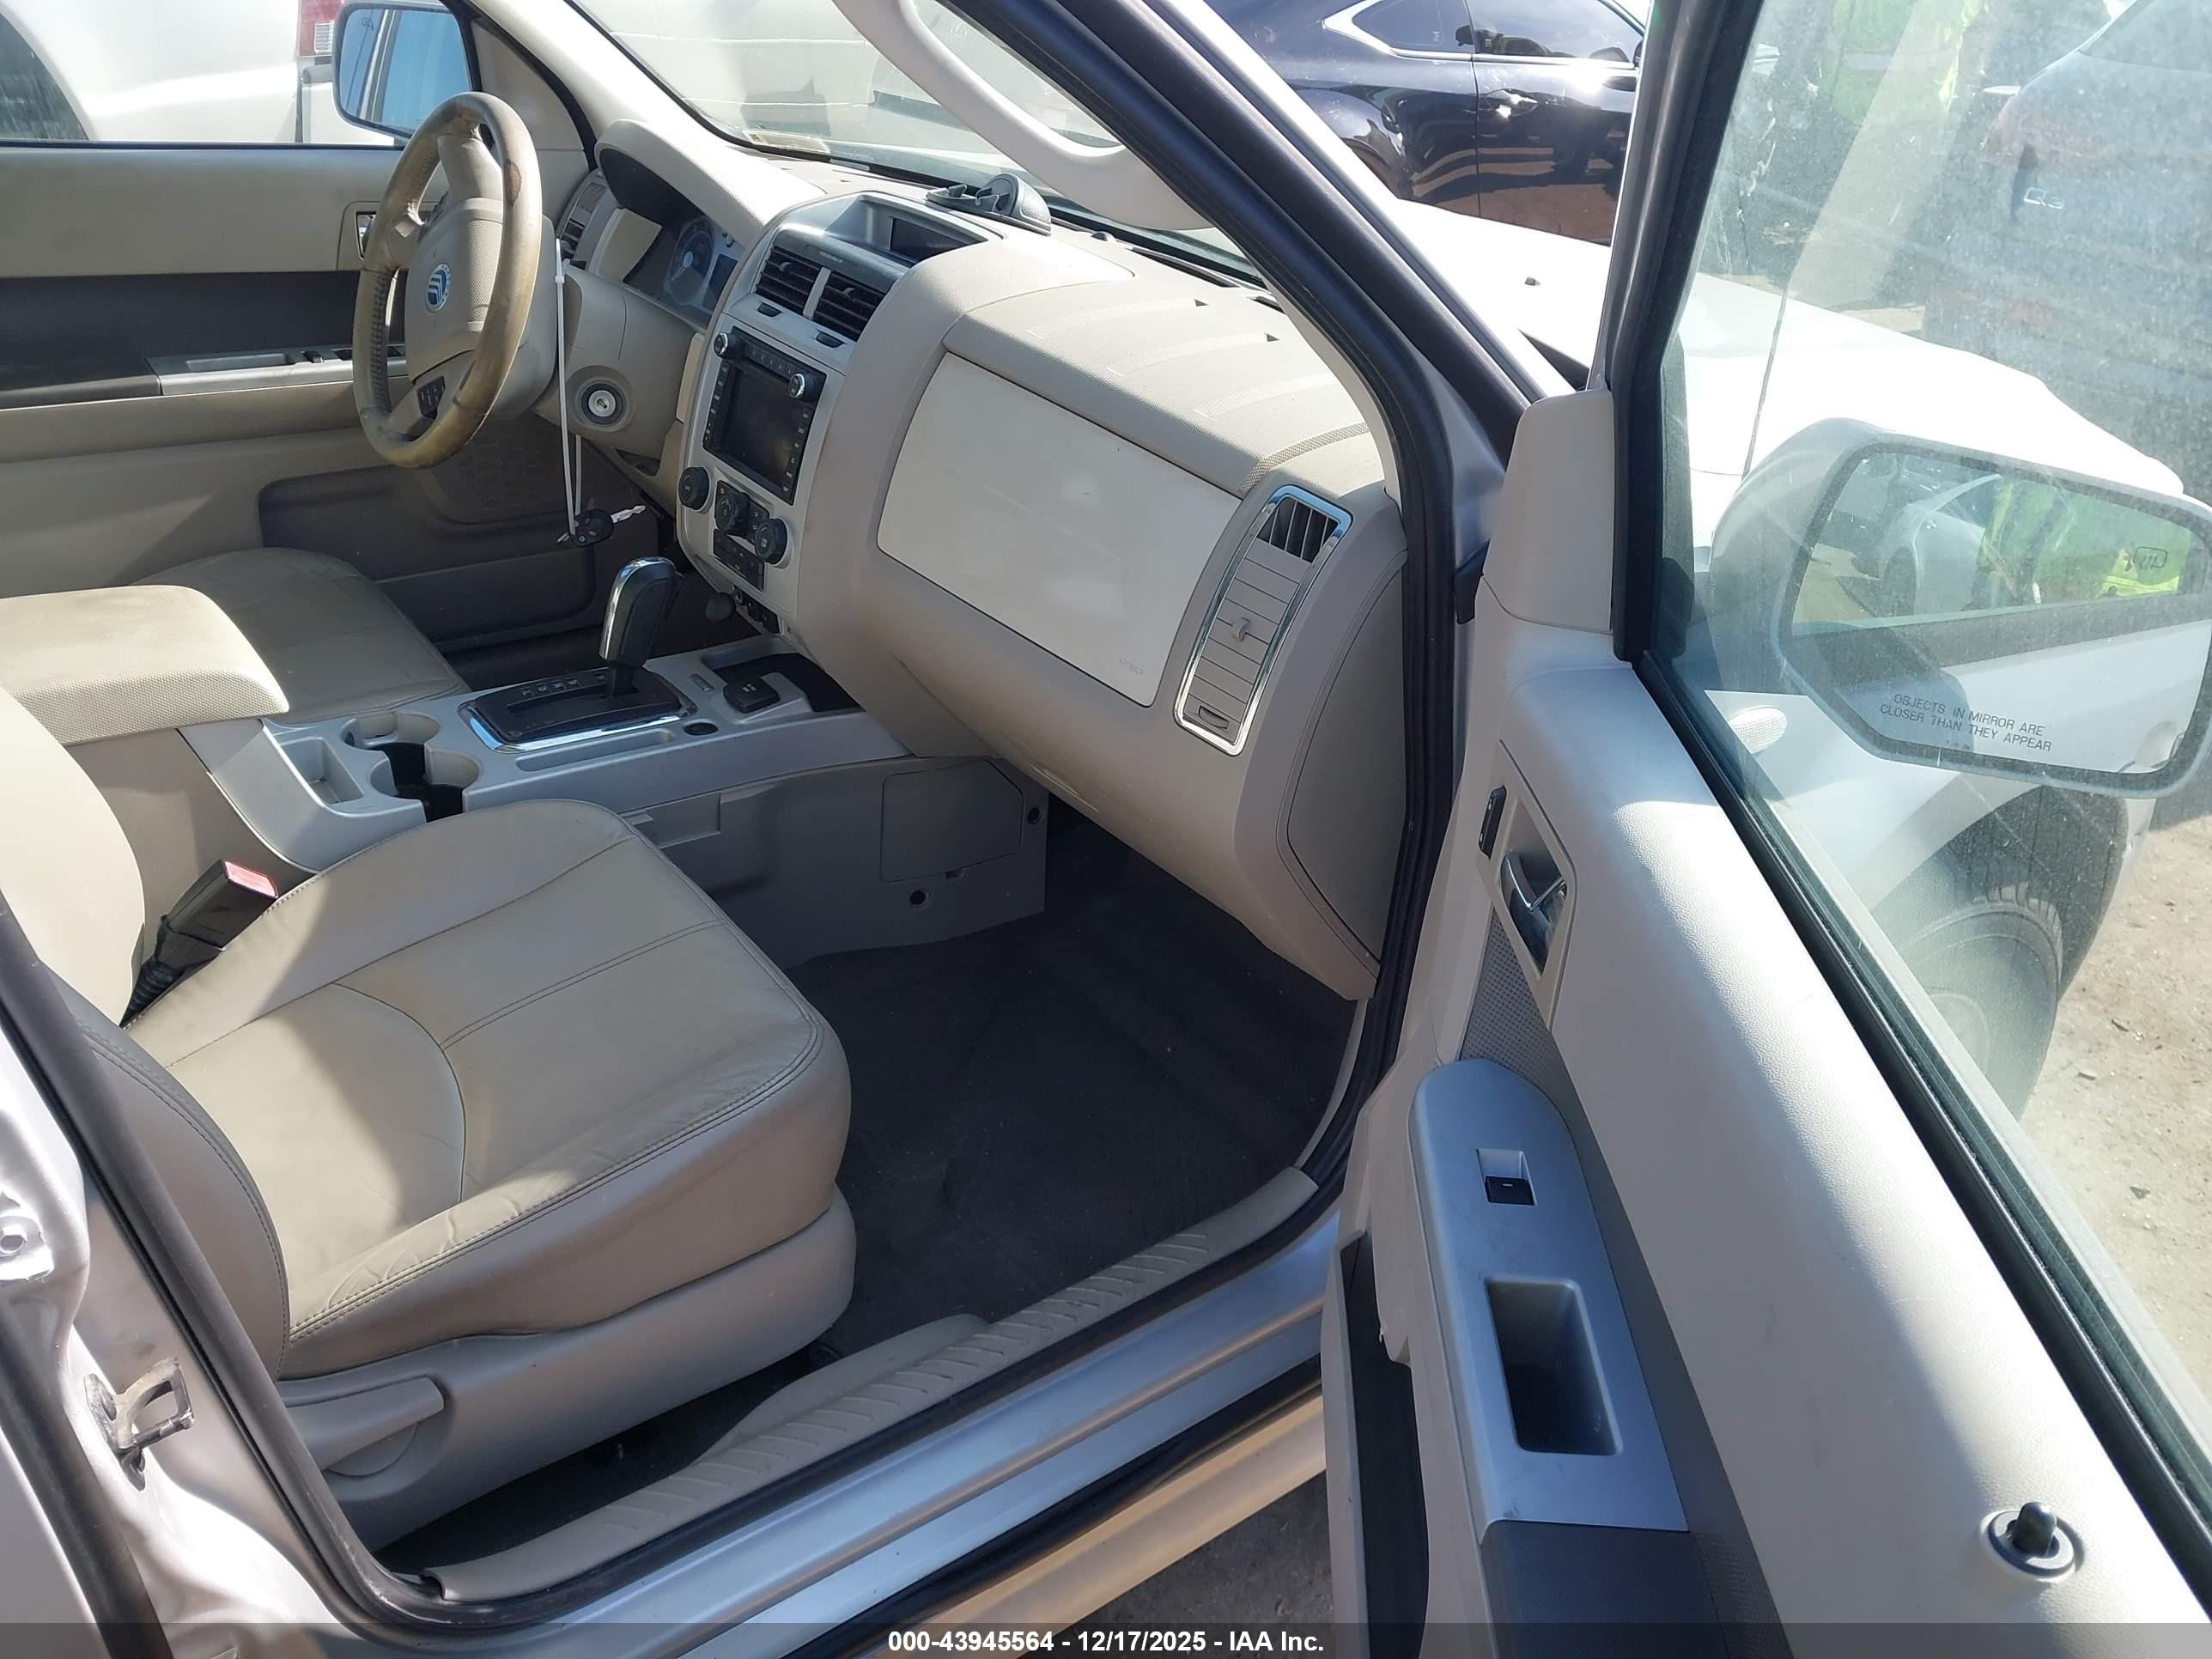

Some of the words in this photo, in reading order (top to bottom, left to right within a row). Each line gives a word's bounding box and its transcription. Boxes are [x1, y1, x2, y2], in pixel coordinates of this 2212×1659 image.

[1880, 703, 1924, 723] CLOSER
[1931, 715, 1962, 732] THAN
[1969, 724, 1999, 740] THEY
[2003, 732, 2052, 752] APPEAR
[1893, 693, 1946, 714] OBJECTS
[1953, 707, 1966, 719] IN
[1968, 710, 2015, 730] MIRROR
[2019, 722, 2045, 737] ARE
